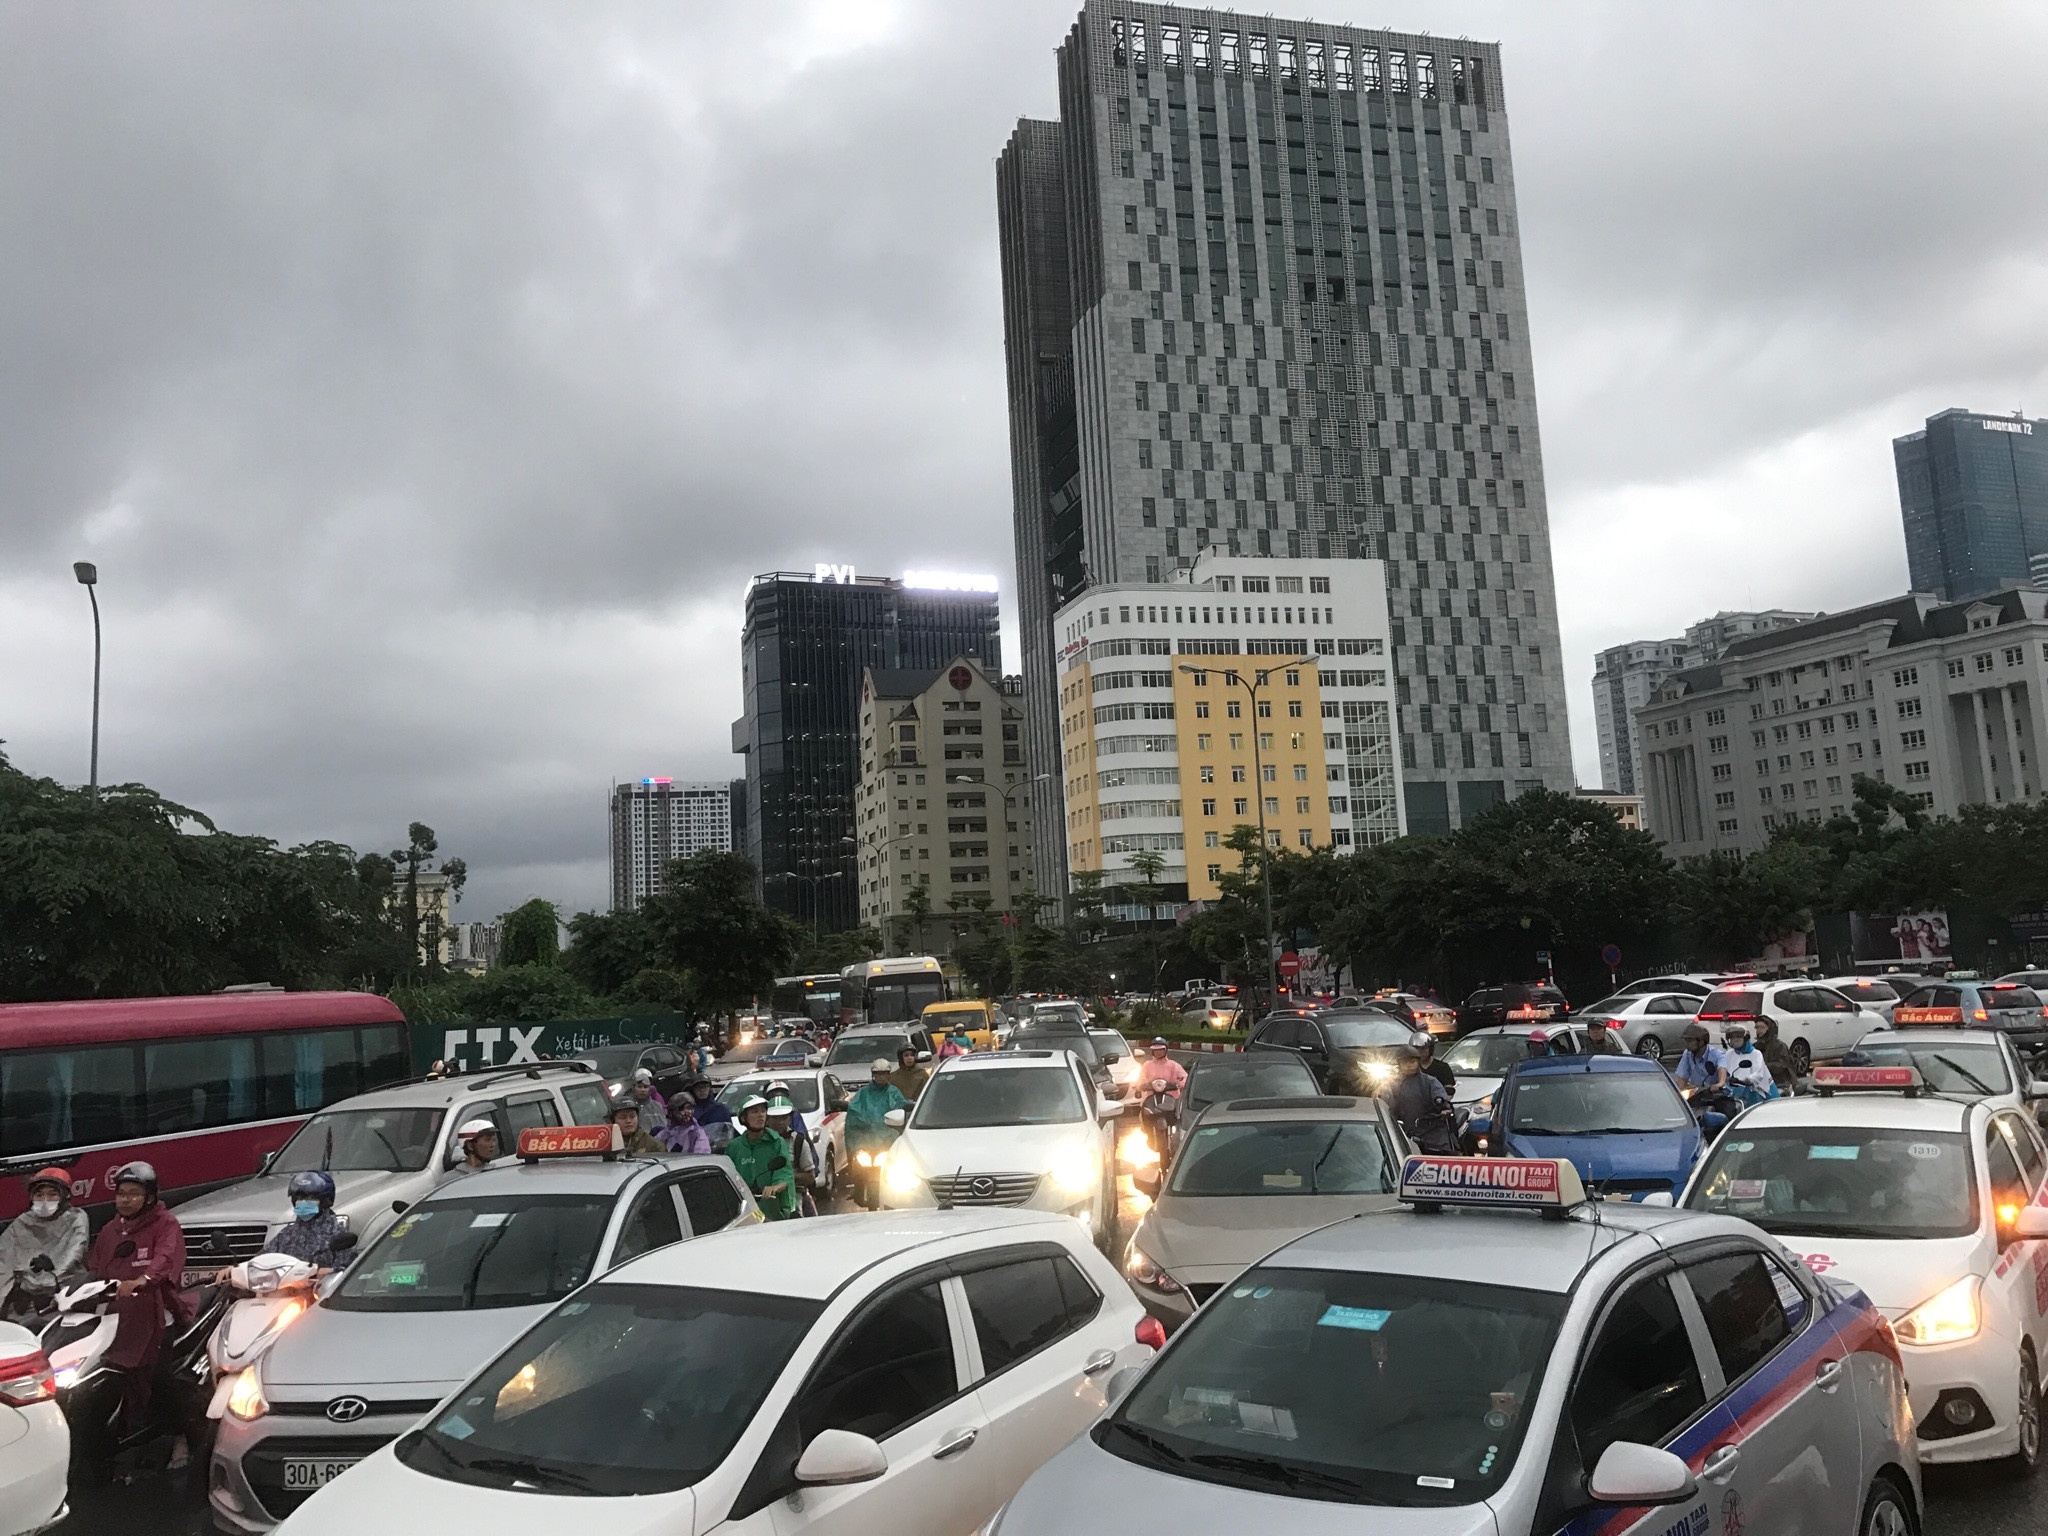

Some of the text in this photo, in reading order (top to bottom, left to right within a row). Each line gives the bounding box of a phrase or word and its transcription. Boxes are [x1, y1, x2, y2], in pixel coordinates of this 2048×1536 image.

[1982, 420, 2033, 435] LANDMARK 72
[815, 563, 856, 585] PVI
[1845, 1071, 1880, 1082] TAXI
[527, 1136, 557, 1151] Bắc
[1423, 1163, 1463, 1185] SAO
[1529, 1167, 1553, 1176] TAXI
[1527, 1178, 1552, 1188] GROUP
[1415, 1188, 1543, 1200] www.saohanoitaxi.com
[1690, 1503, 1708, 1523] TAXI
